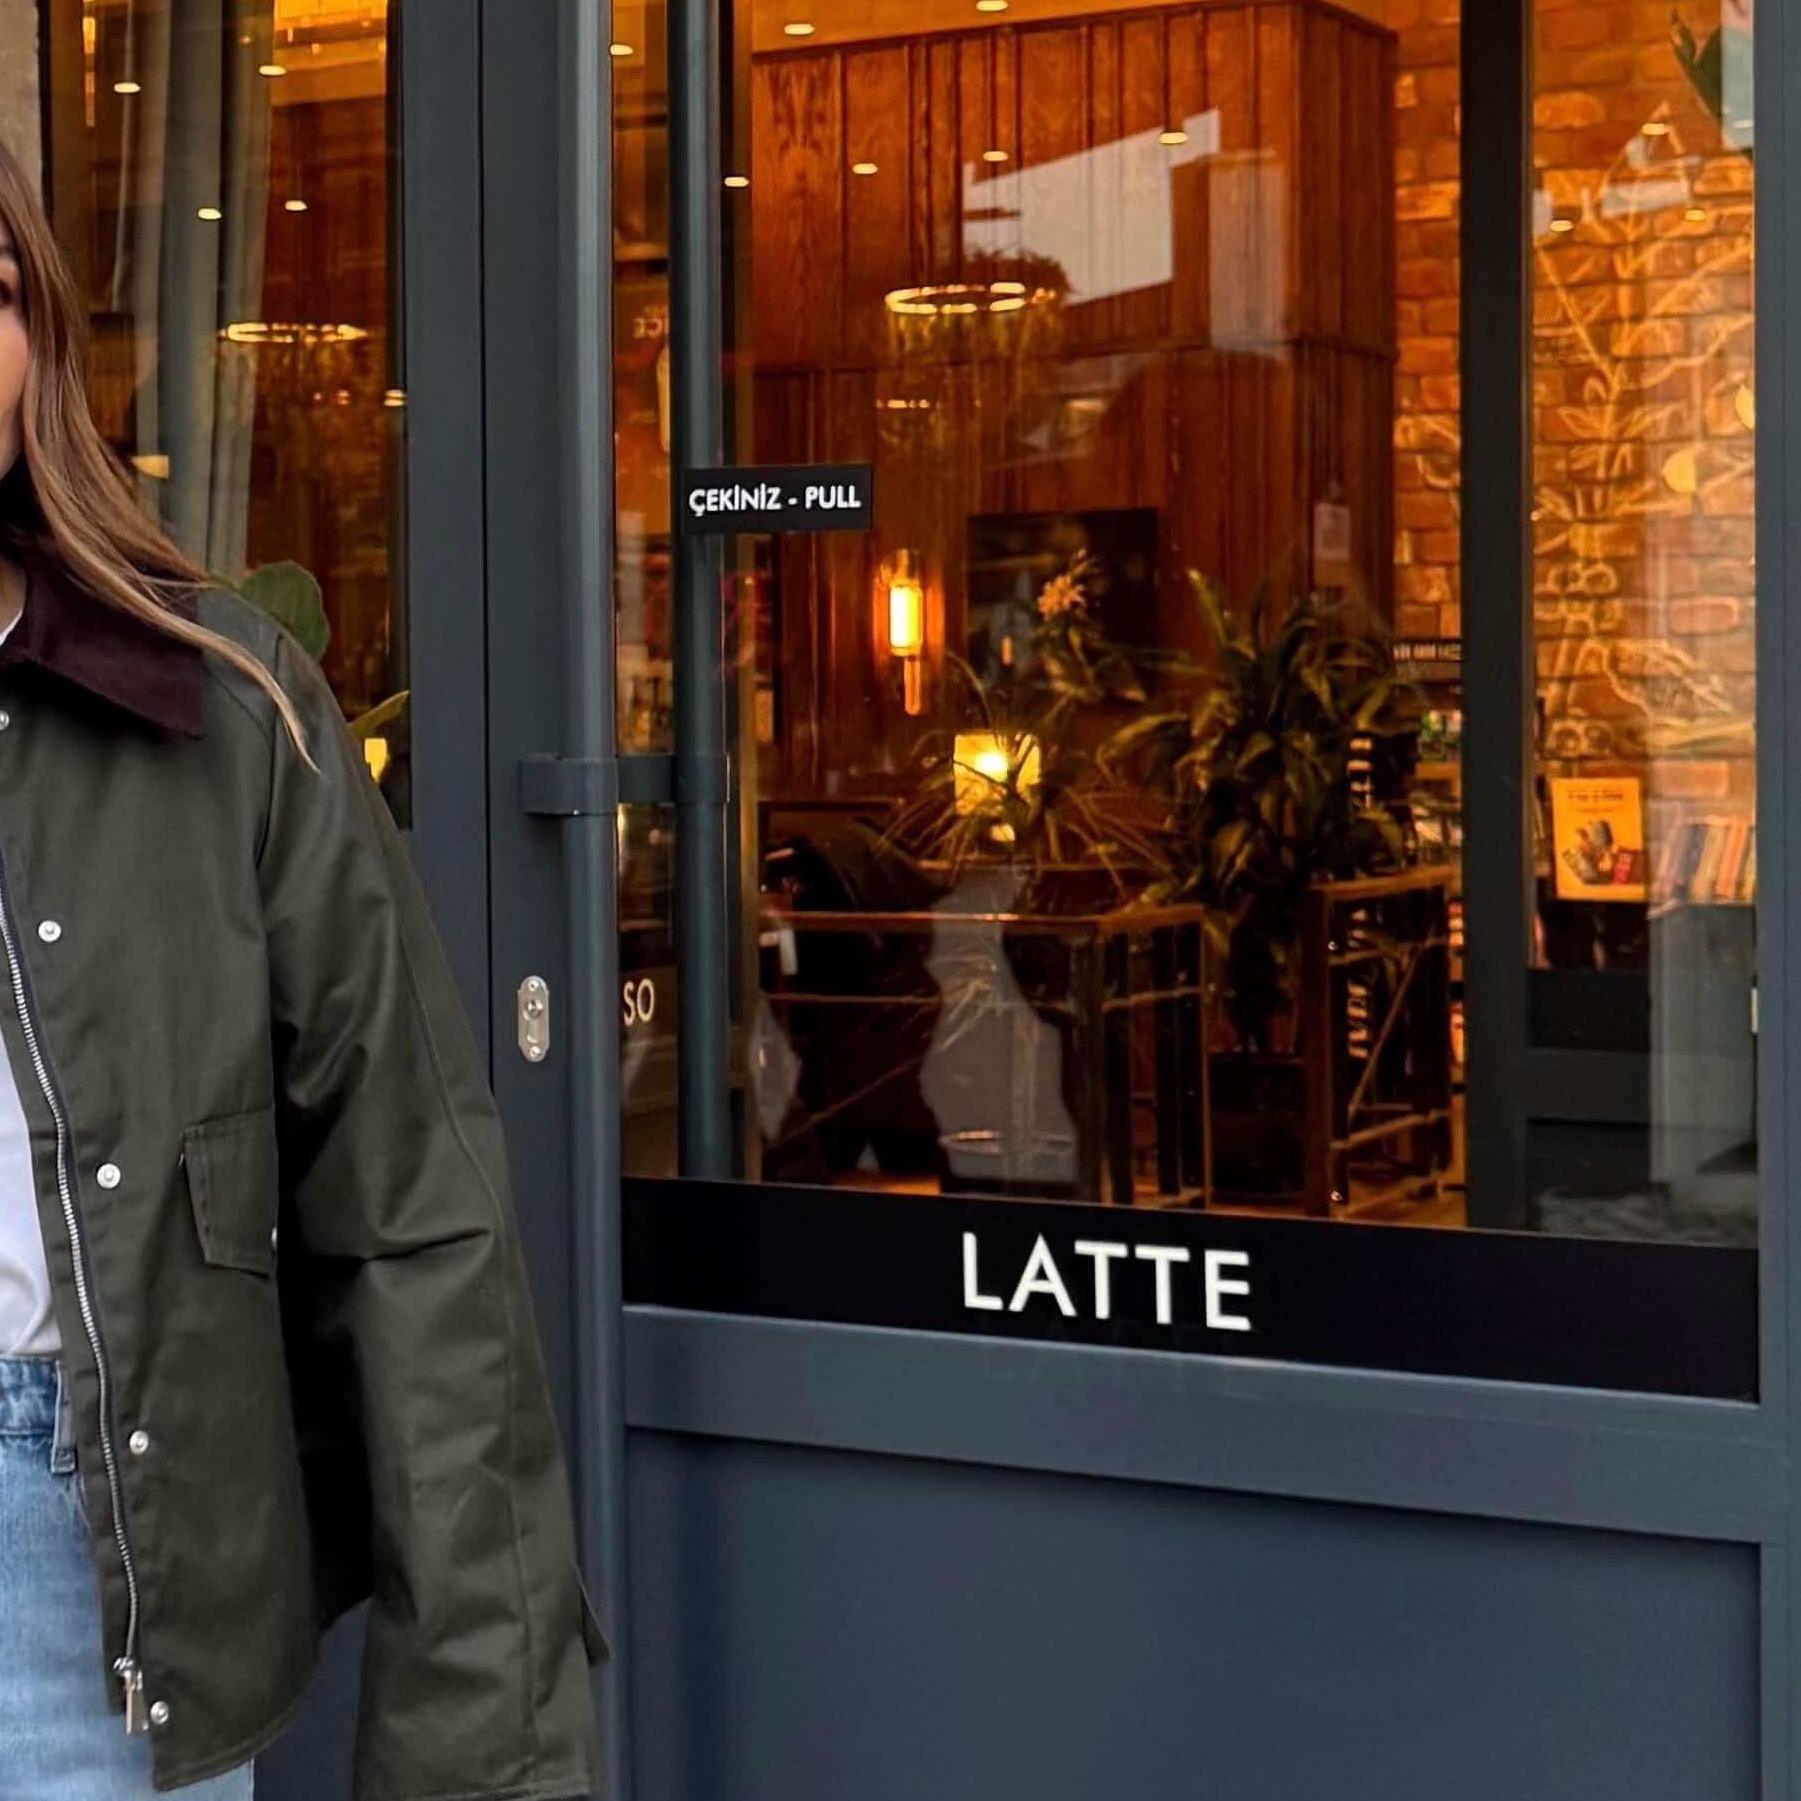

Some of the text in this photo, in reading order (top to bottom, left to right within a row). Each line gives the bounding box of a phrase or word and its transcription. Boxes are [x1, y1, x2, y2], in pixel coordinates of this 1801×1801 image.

[688, 483, 782, 517] ÇEKİNİZ
[805, 485, 862, 510] PULL
[962, 1231, 1251, 1331] LATTE
